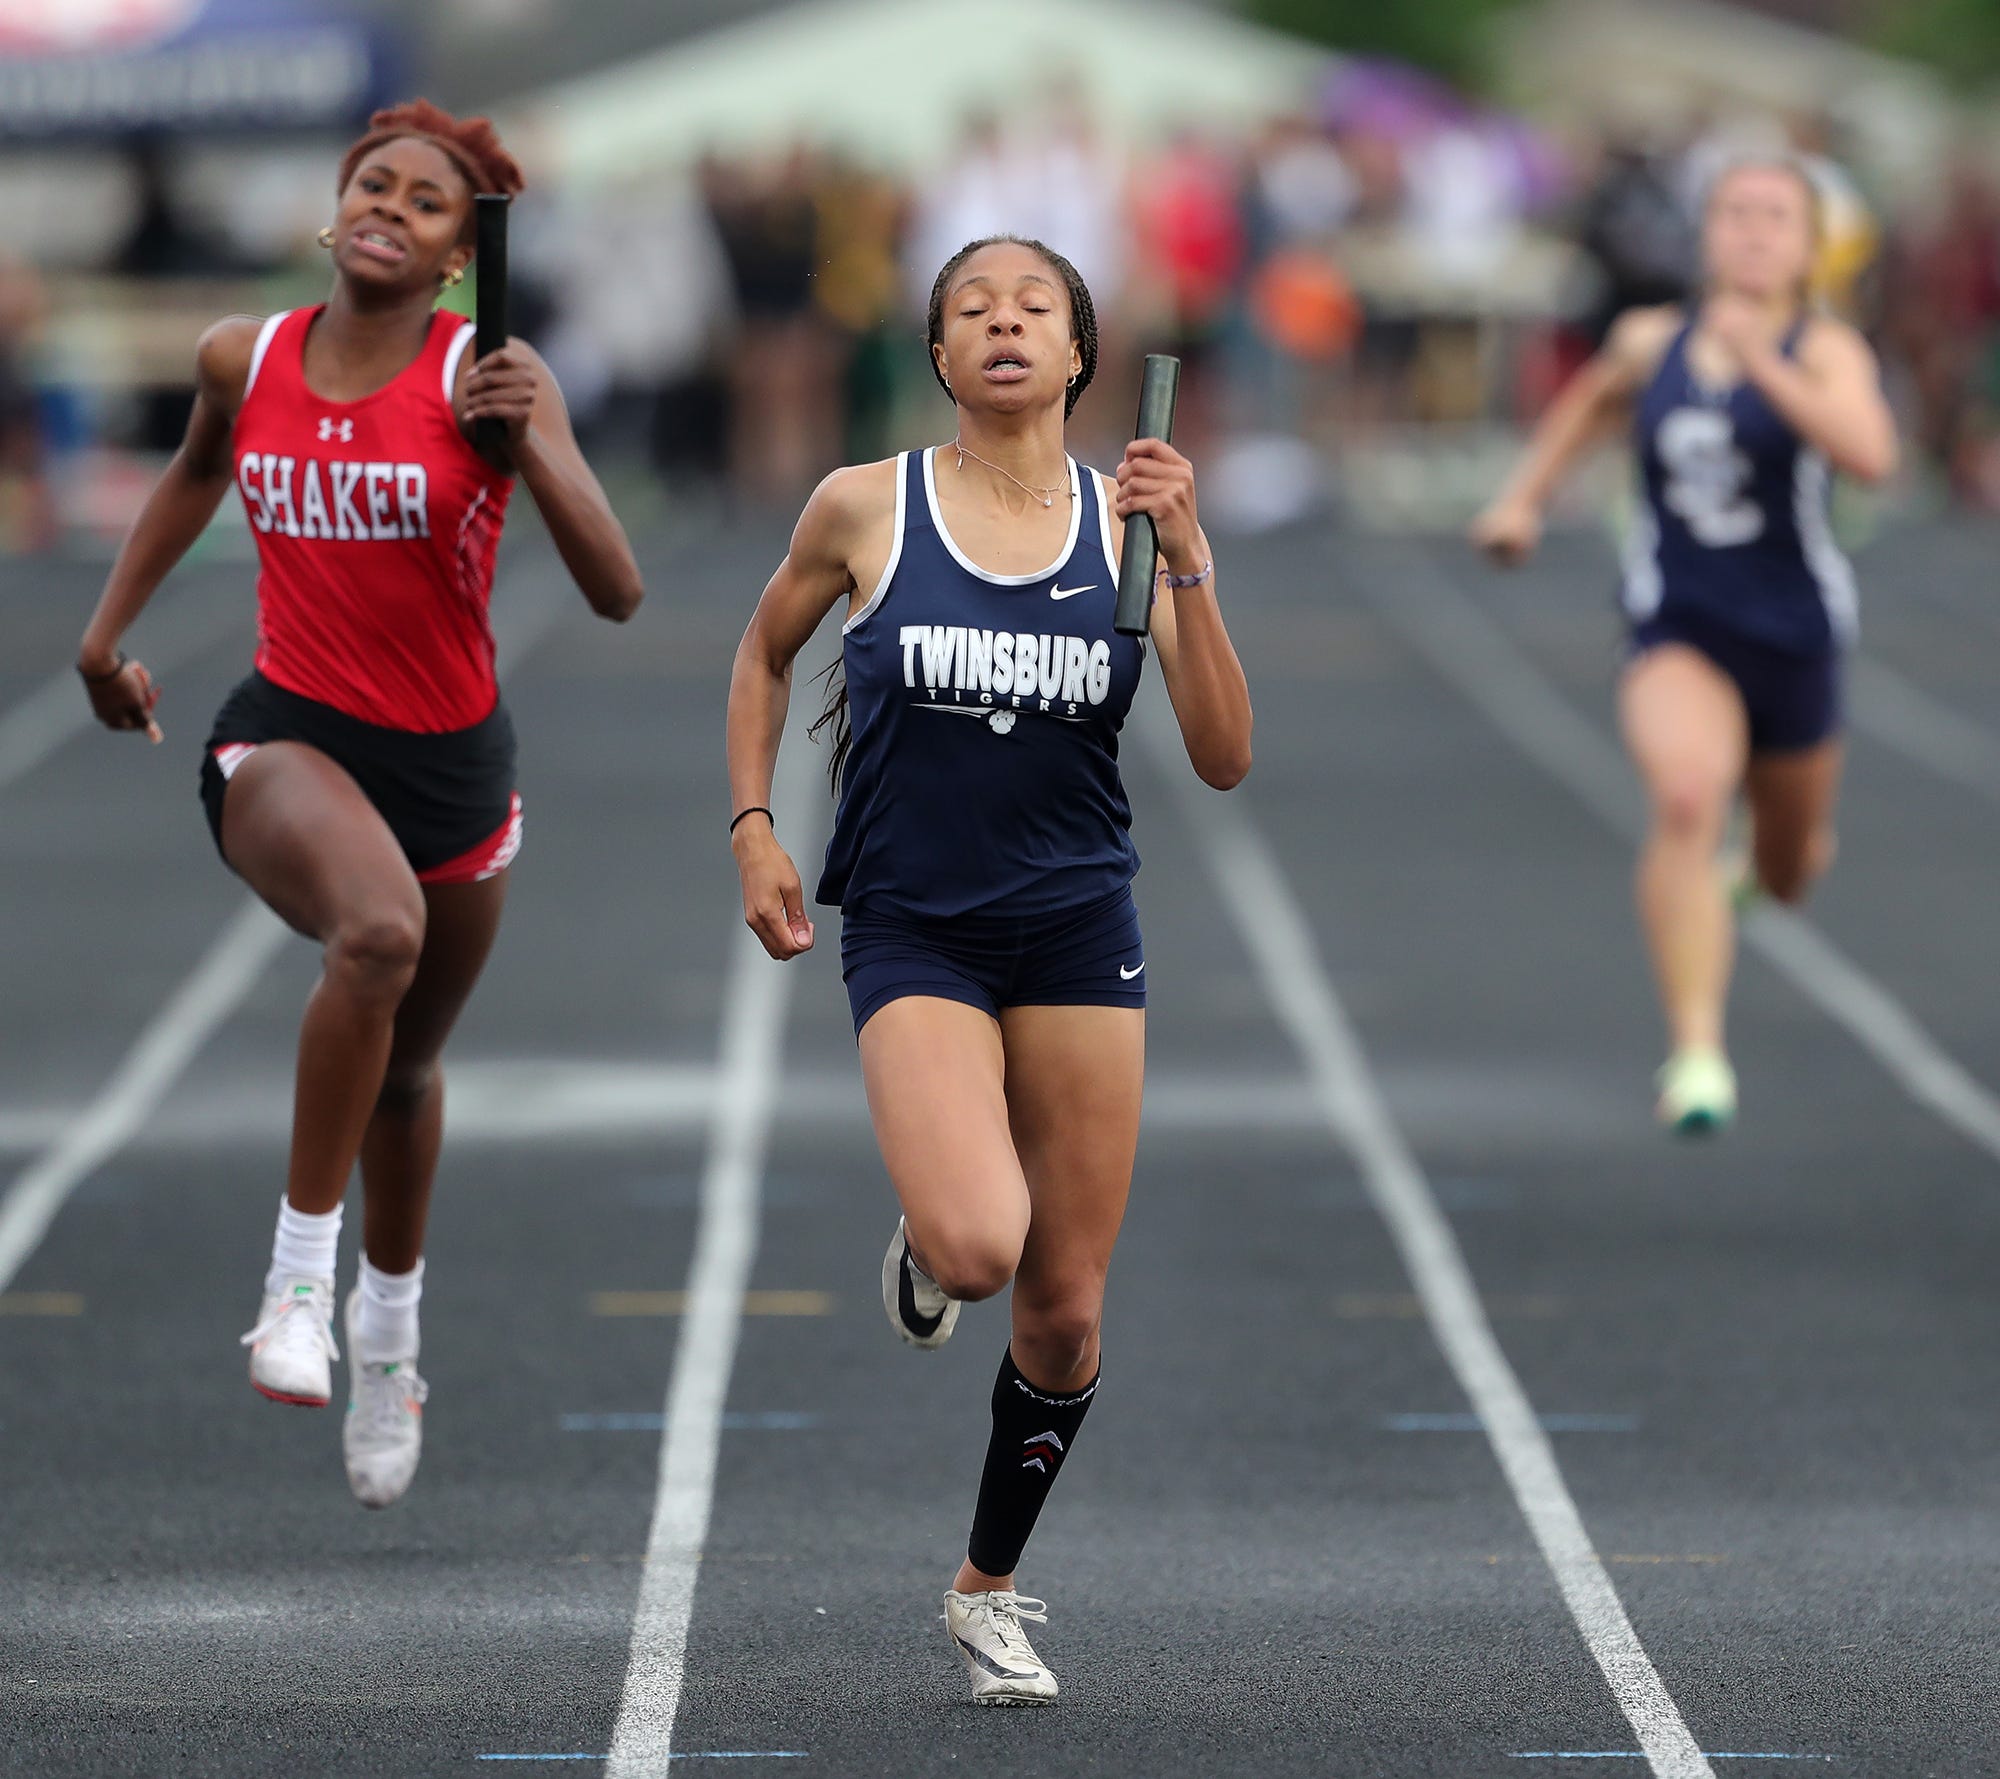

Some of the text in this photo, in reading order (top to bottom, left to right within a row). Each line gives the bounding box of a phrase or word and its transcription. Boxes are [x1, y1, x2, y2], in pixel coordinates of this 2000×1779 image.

[239, 451, 431, 541] SHAKER
[899, 625, 1112, 706] TWINSBURG
[928, 689, 1077, 715] TIGERS
